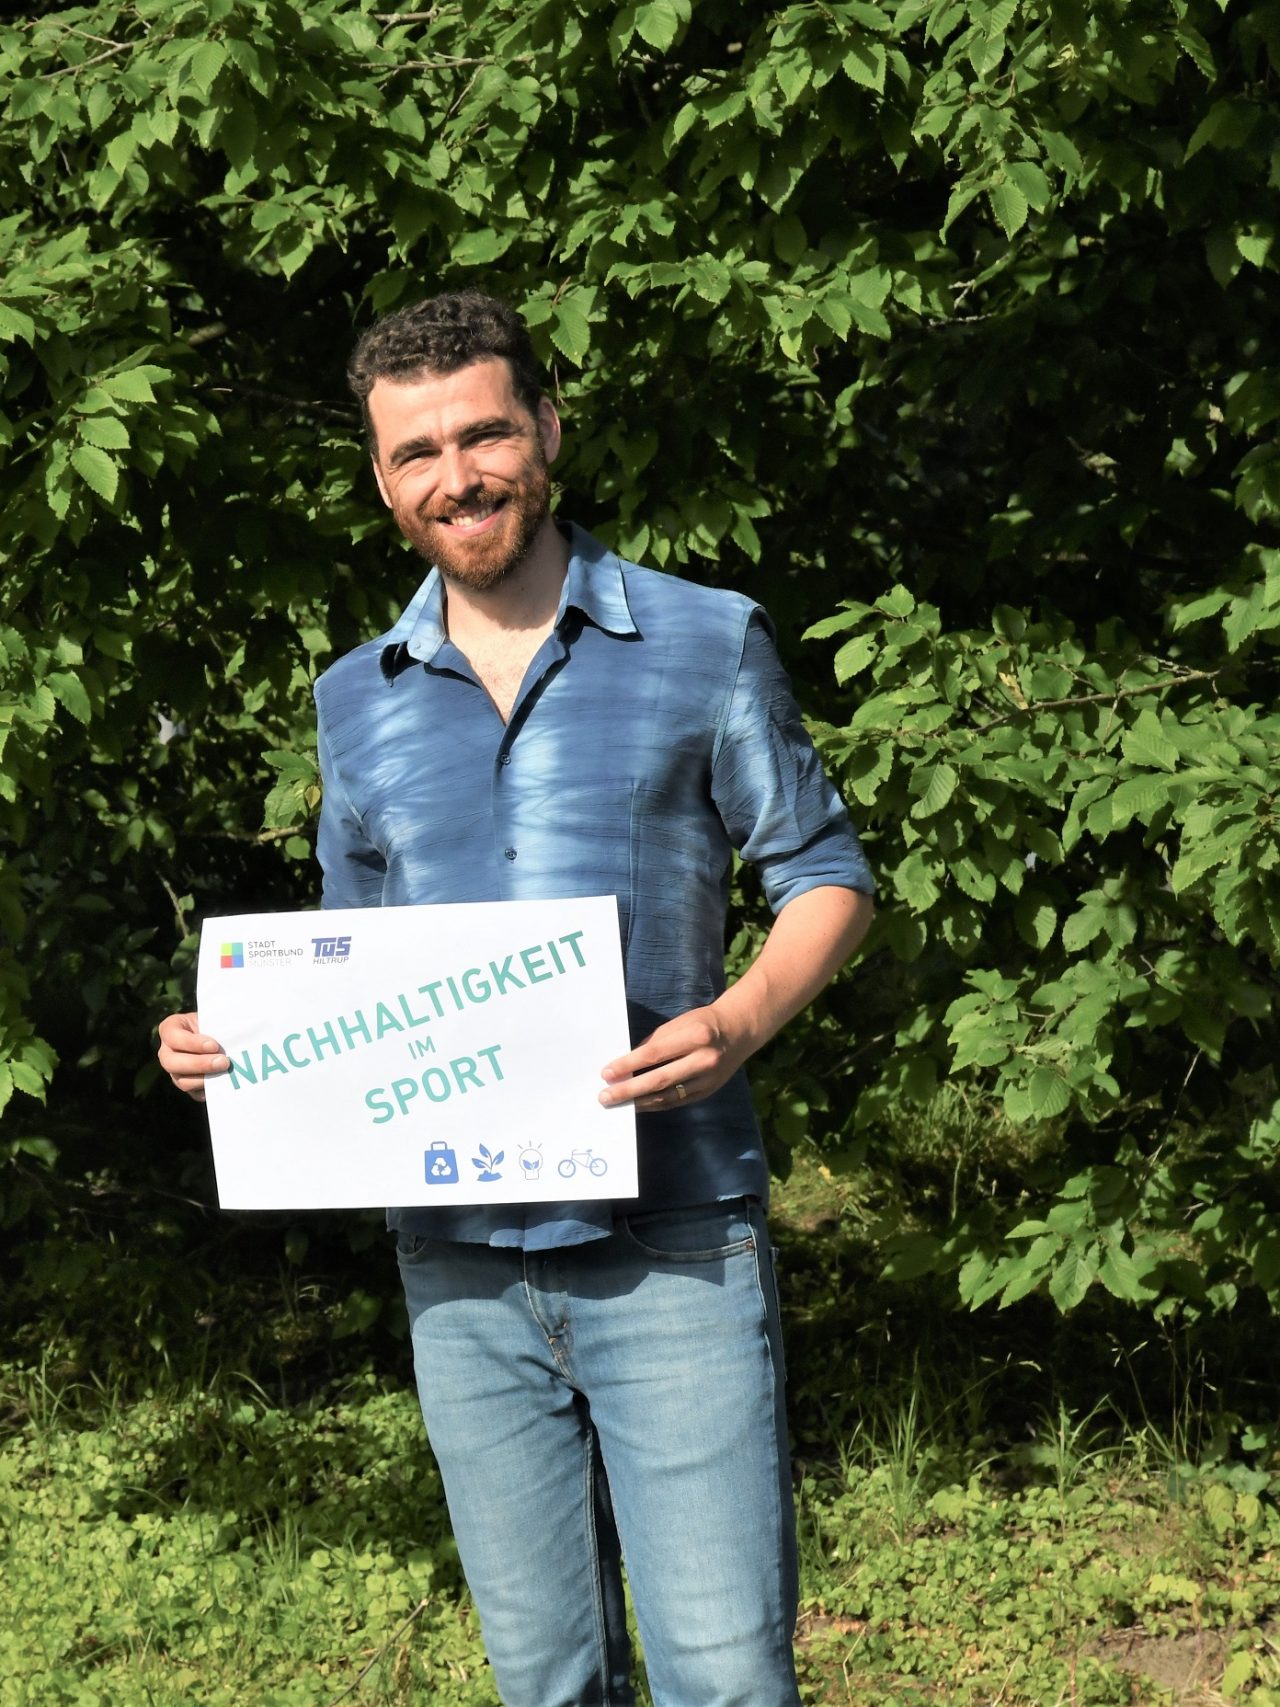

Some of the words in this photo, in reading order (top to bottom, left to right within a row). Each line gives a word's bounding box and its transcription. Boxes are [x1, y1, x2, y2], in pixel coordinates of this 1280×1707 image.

[248, 940, 276, 949] STADT
[249, 948, 304, 958] SPORTBUND
[313, 957, 349, 965] HILTRUP
[227, 930, 588, 1090] NACHHALTIGKEIT
[408, 1036, 436, 1060] IM
[364, 1044, 505, 1124] SPORT
